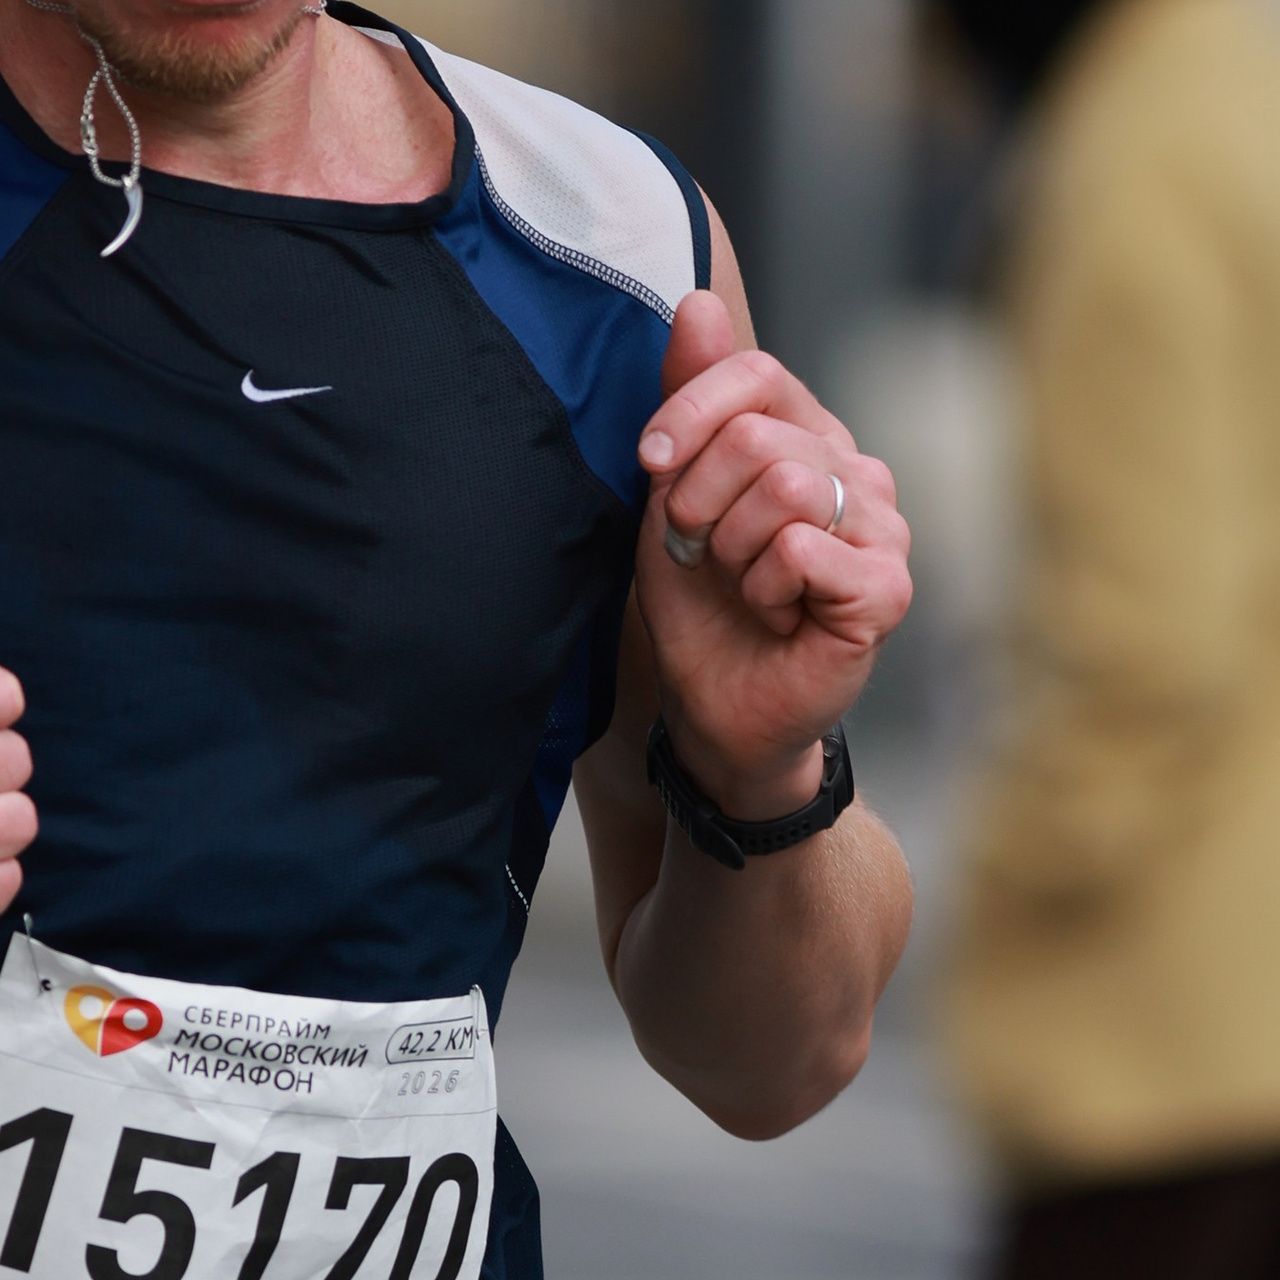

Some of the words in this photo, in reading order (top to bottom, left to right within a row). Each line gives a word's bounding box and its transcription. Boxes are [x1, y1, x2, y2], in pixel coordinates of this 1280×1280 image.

[183, 1005, 332, 1041] СБЕРПРАЙМ
[172, 1028, 370, 1068] МОСКОВСКИЙ
[398, 1029, 442, 1057] 42,2
[167, 1051, 314, 1094] МАРАФОН
[397, 1069, 461, 1097] 2026
